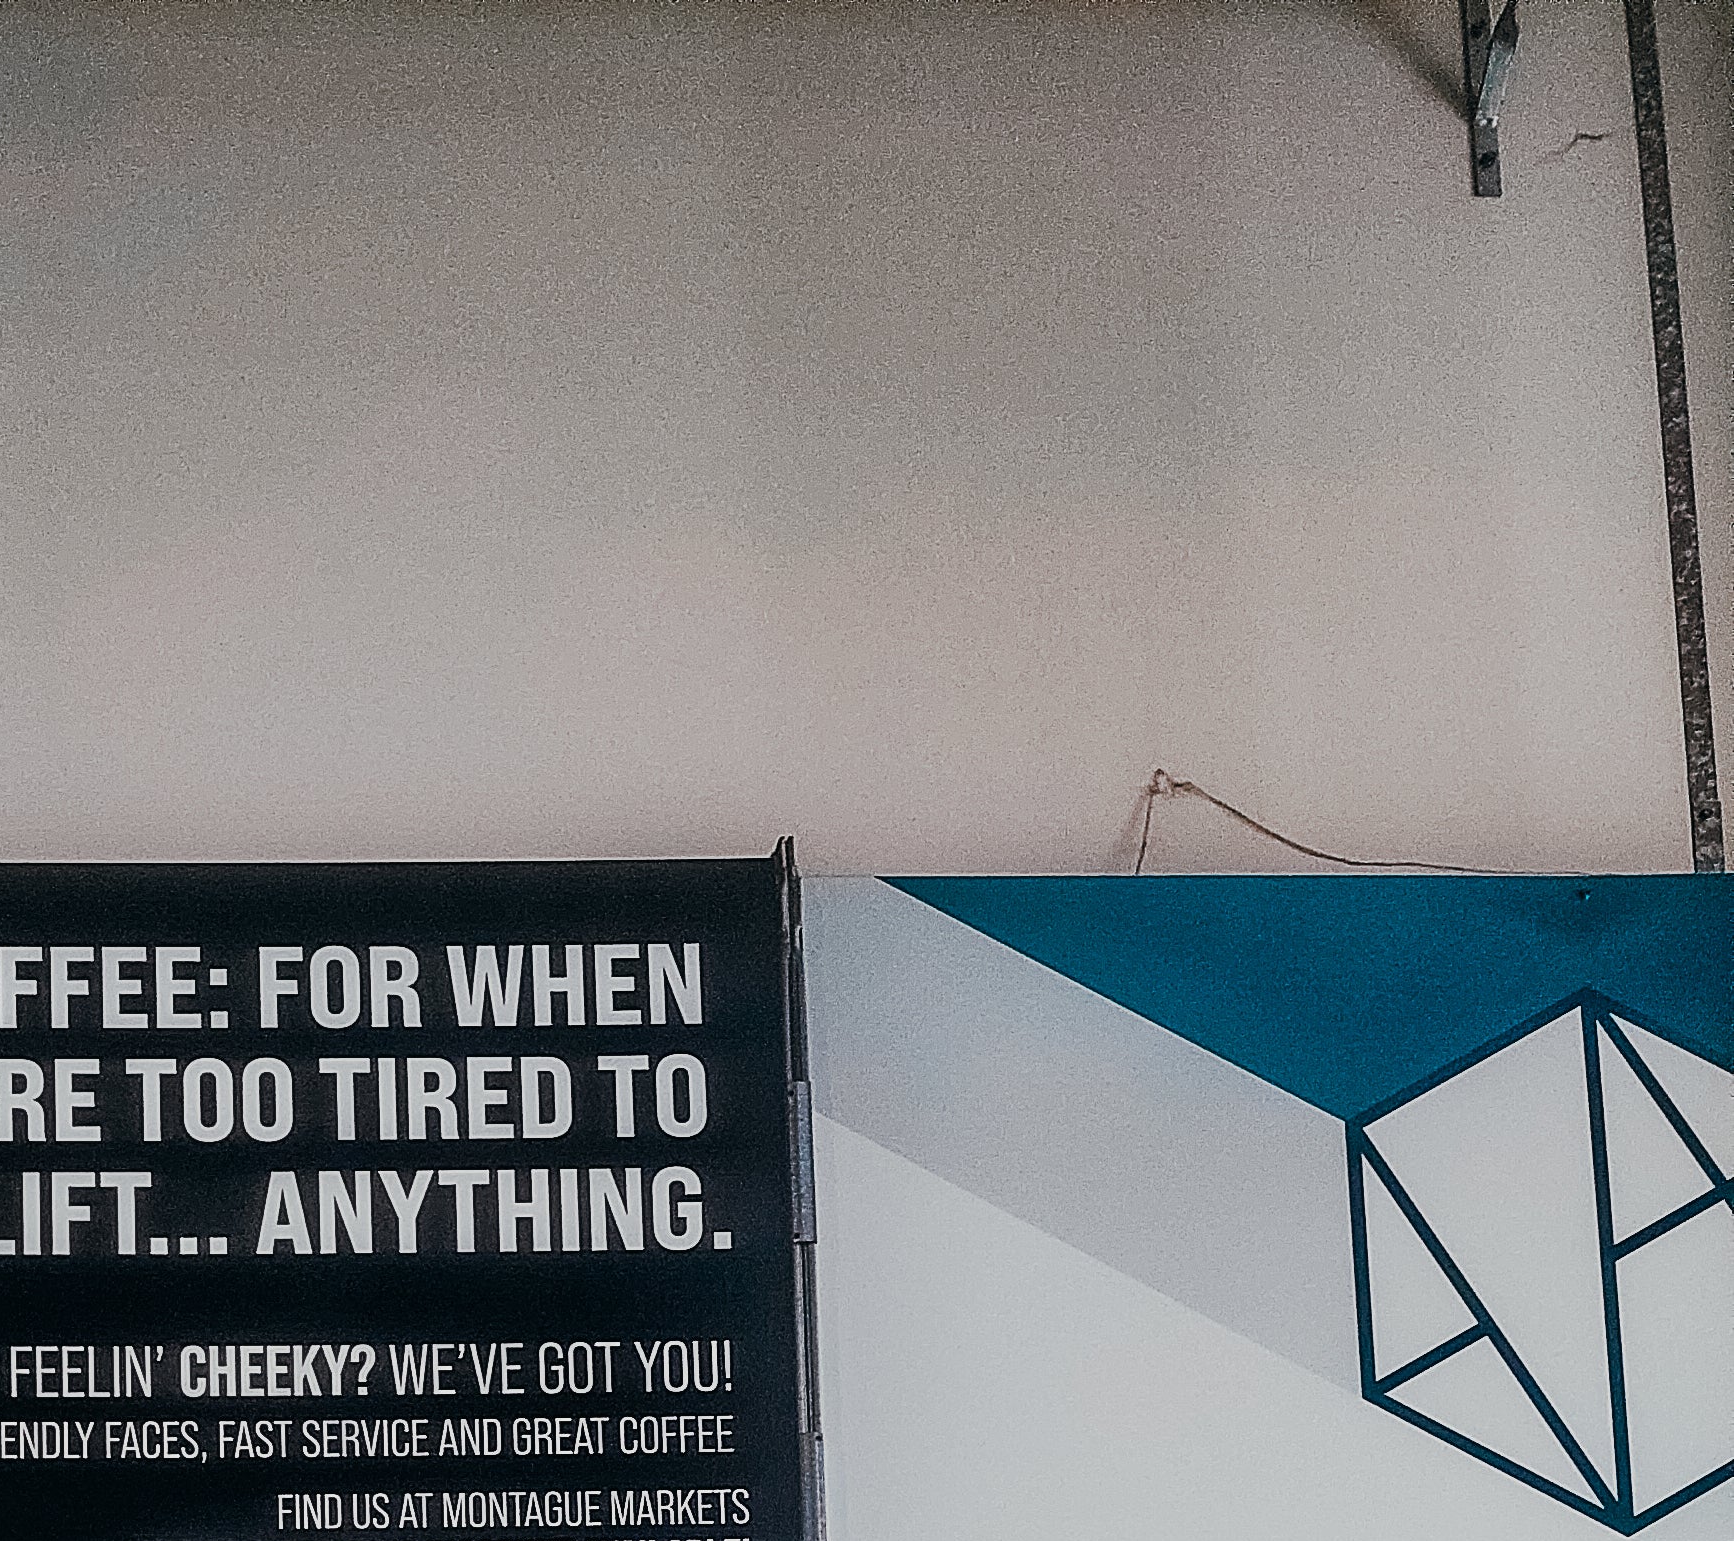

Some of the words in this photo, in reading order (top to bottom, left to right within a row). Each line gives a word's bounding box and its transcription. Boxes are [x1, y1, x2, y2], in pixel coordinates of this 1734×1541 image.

[258, 945, 423, 1029] FOR
[445, 942, 703, 1027] WHEN
[125, 1057, 294, 1143] TOO
[318, 1056, 573, 1141] TIRED
[597, 1053, 708, 1138] TO
[255, 1165, 733, 1255] ANYTHING.
[10, 1345, 164, 1398] FEELIN’
[180, 1343, 376, 1398] CHEEKY?
[388, 1342, 525, 1396] WE’VE
[538, 1341, 621, 1395] GOT
[633, 1339, 732, 1393] YOU!
[105, 1420, 208, 1464] FACES,
[218, 1420, 293, 1459] FAST
[302, 1418, 430, 1458] SERVICE
[438, 1418, 502, 1457] AND
[512, 1416, 610, 1456] GREAT
[619, 1414, 736, 1455] COFFEE
[277, 1493, 343, 1530] FIND
[352, 1492, 390, 1530] US
[398, 1492, 434, 1529] AT
[442, 1490, 602, 1528] MONTAGUE
[610, 1488, 750, 1526] MARKETS
